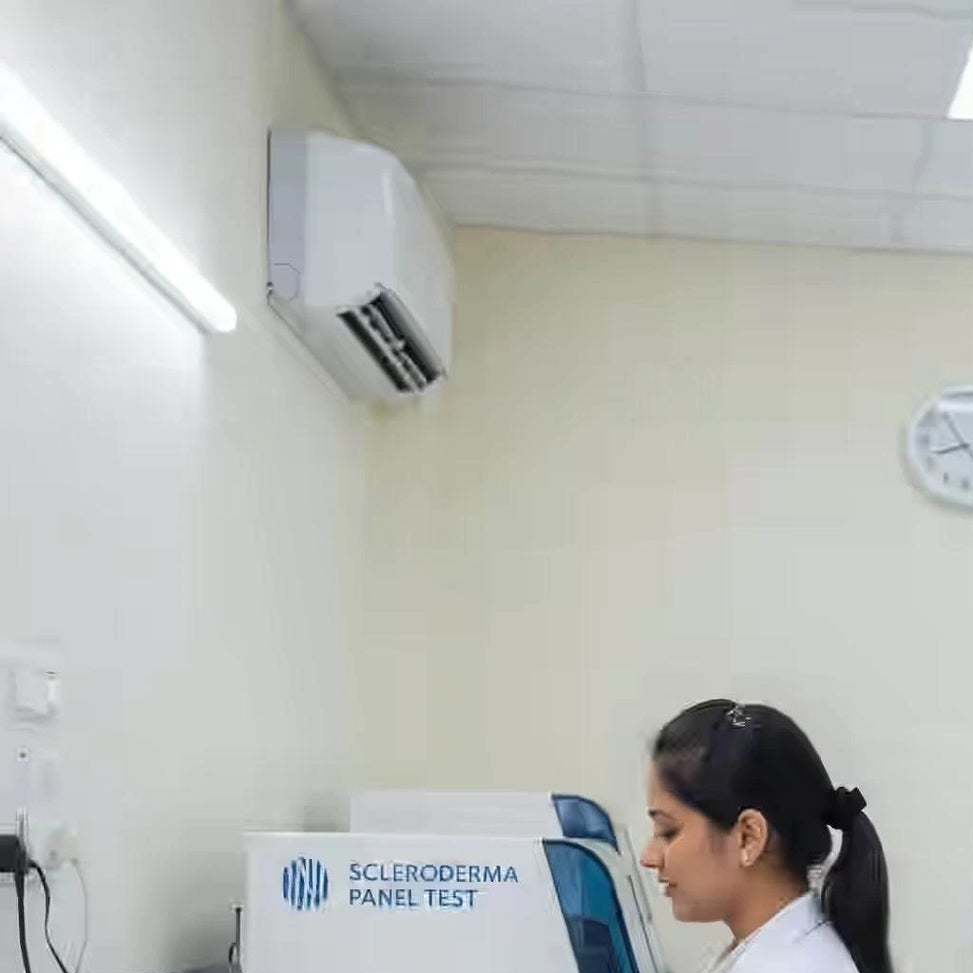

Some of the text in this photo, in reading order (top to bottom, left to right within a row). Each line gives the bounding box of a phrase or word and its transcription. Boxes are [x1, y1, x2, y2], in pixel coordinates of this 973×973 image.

[348, 862, 519, 884] SCLERODERMA
[348, 888, 478, 908] PANEL TEST
